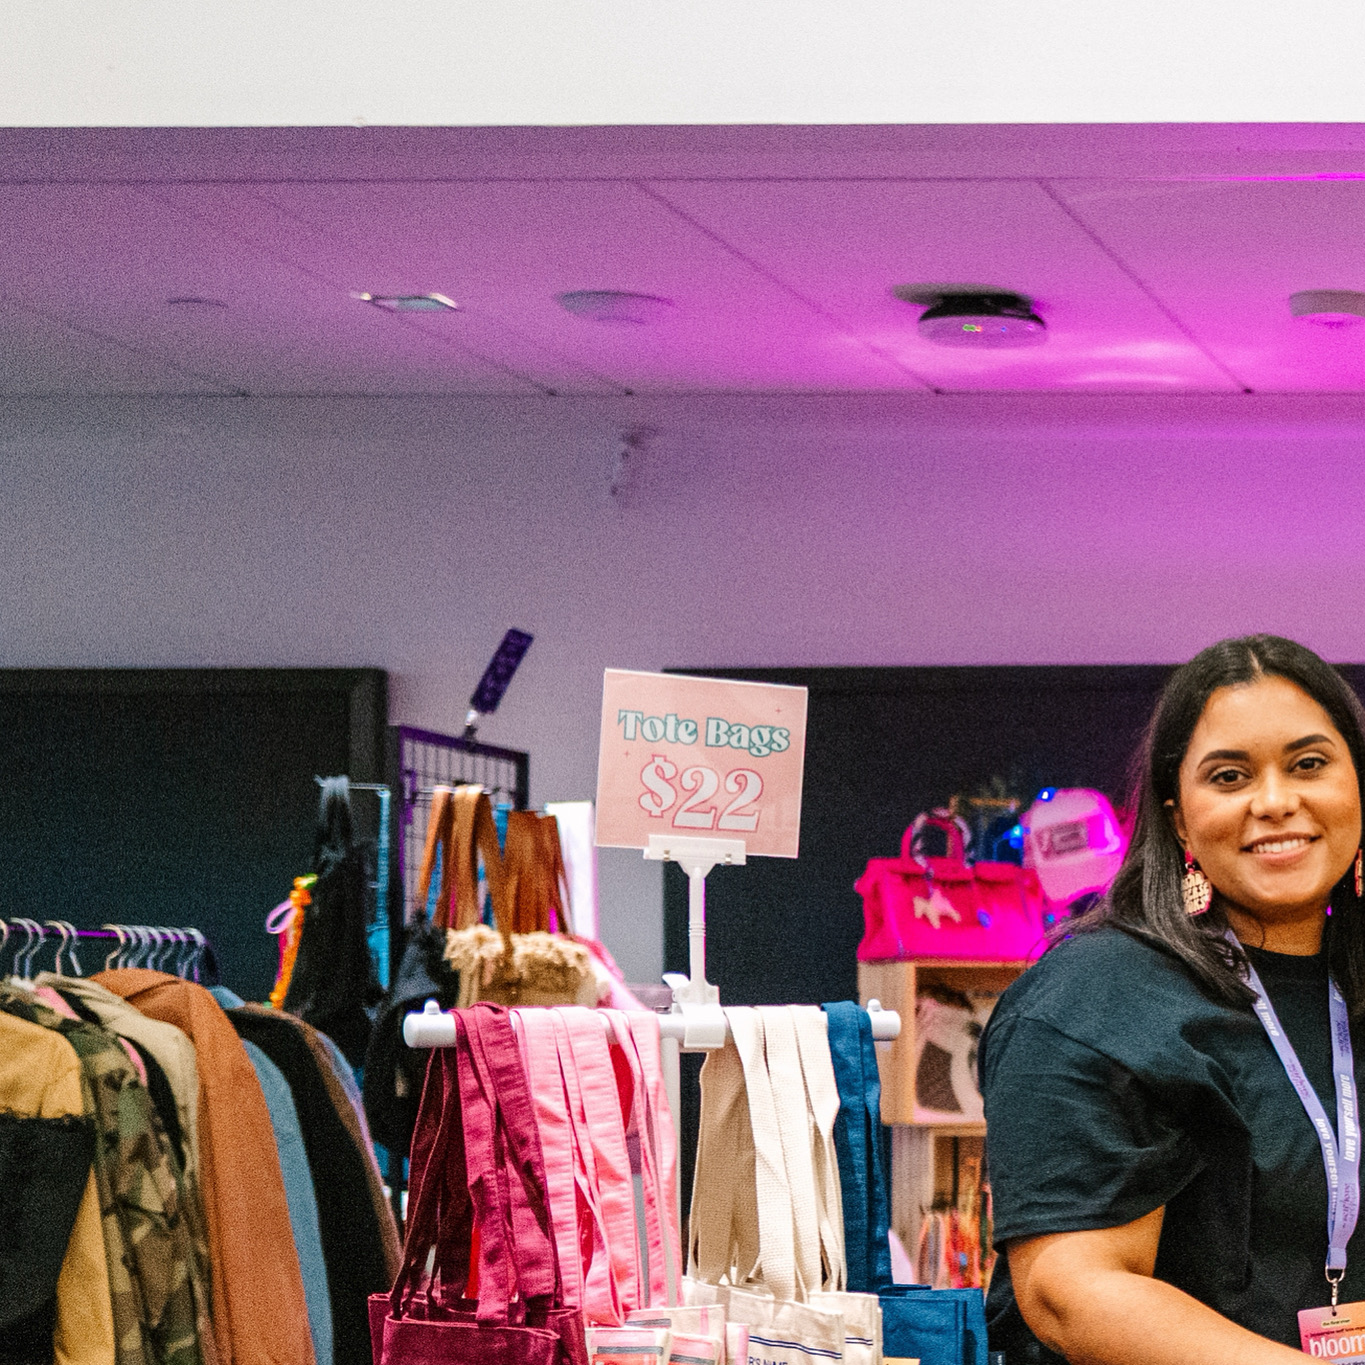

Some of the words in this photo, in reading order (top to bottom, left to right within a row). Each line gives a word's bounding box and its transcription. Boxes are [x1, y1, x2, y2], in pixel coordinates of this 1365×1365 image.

[618, 709, 698, 745] Tote
[705, 717, 790, 757] Bags
[638, 754, 765, 833] $22
[1340, 1074, 1352, 1099] more
[1315, 1118, 1331, 1140] love
[1341, 1099, 1358, 1138] yourself
[1344, 1137, 1356, 1162] love
